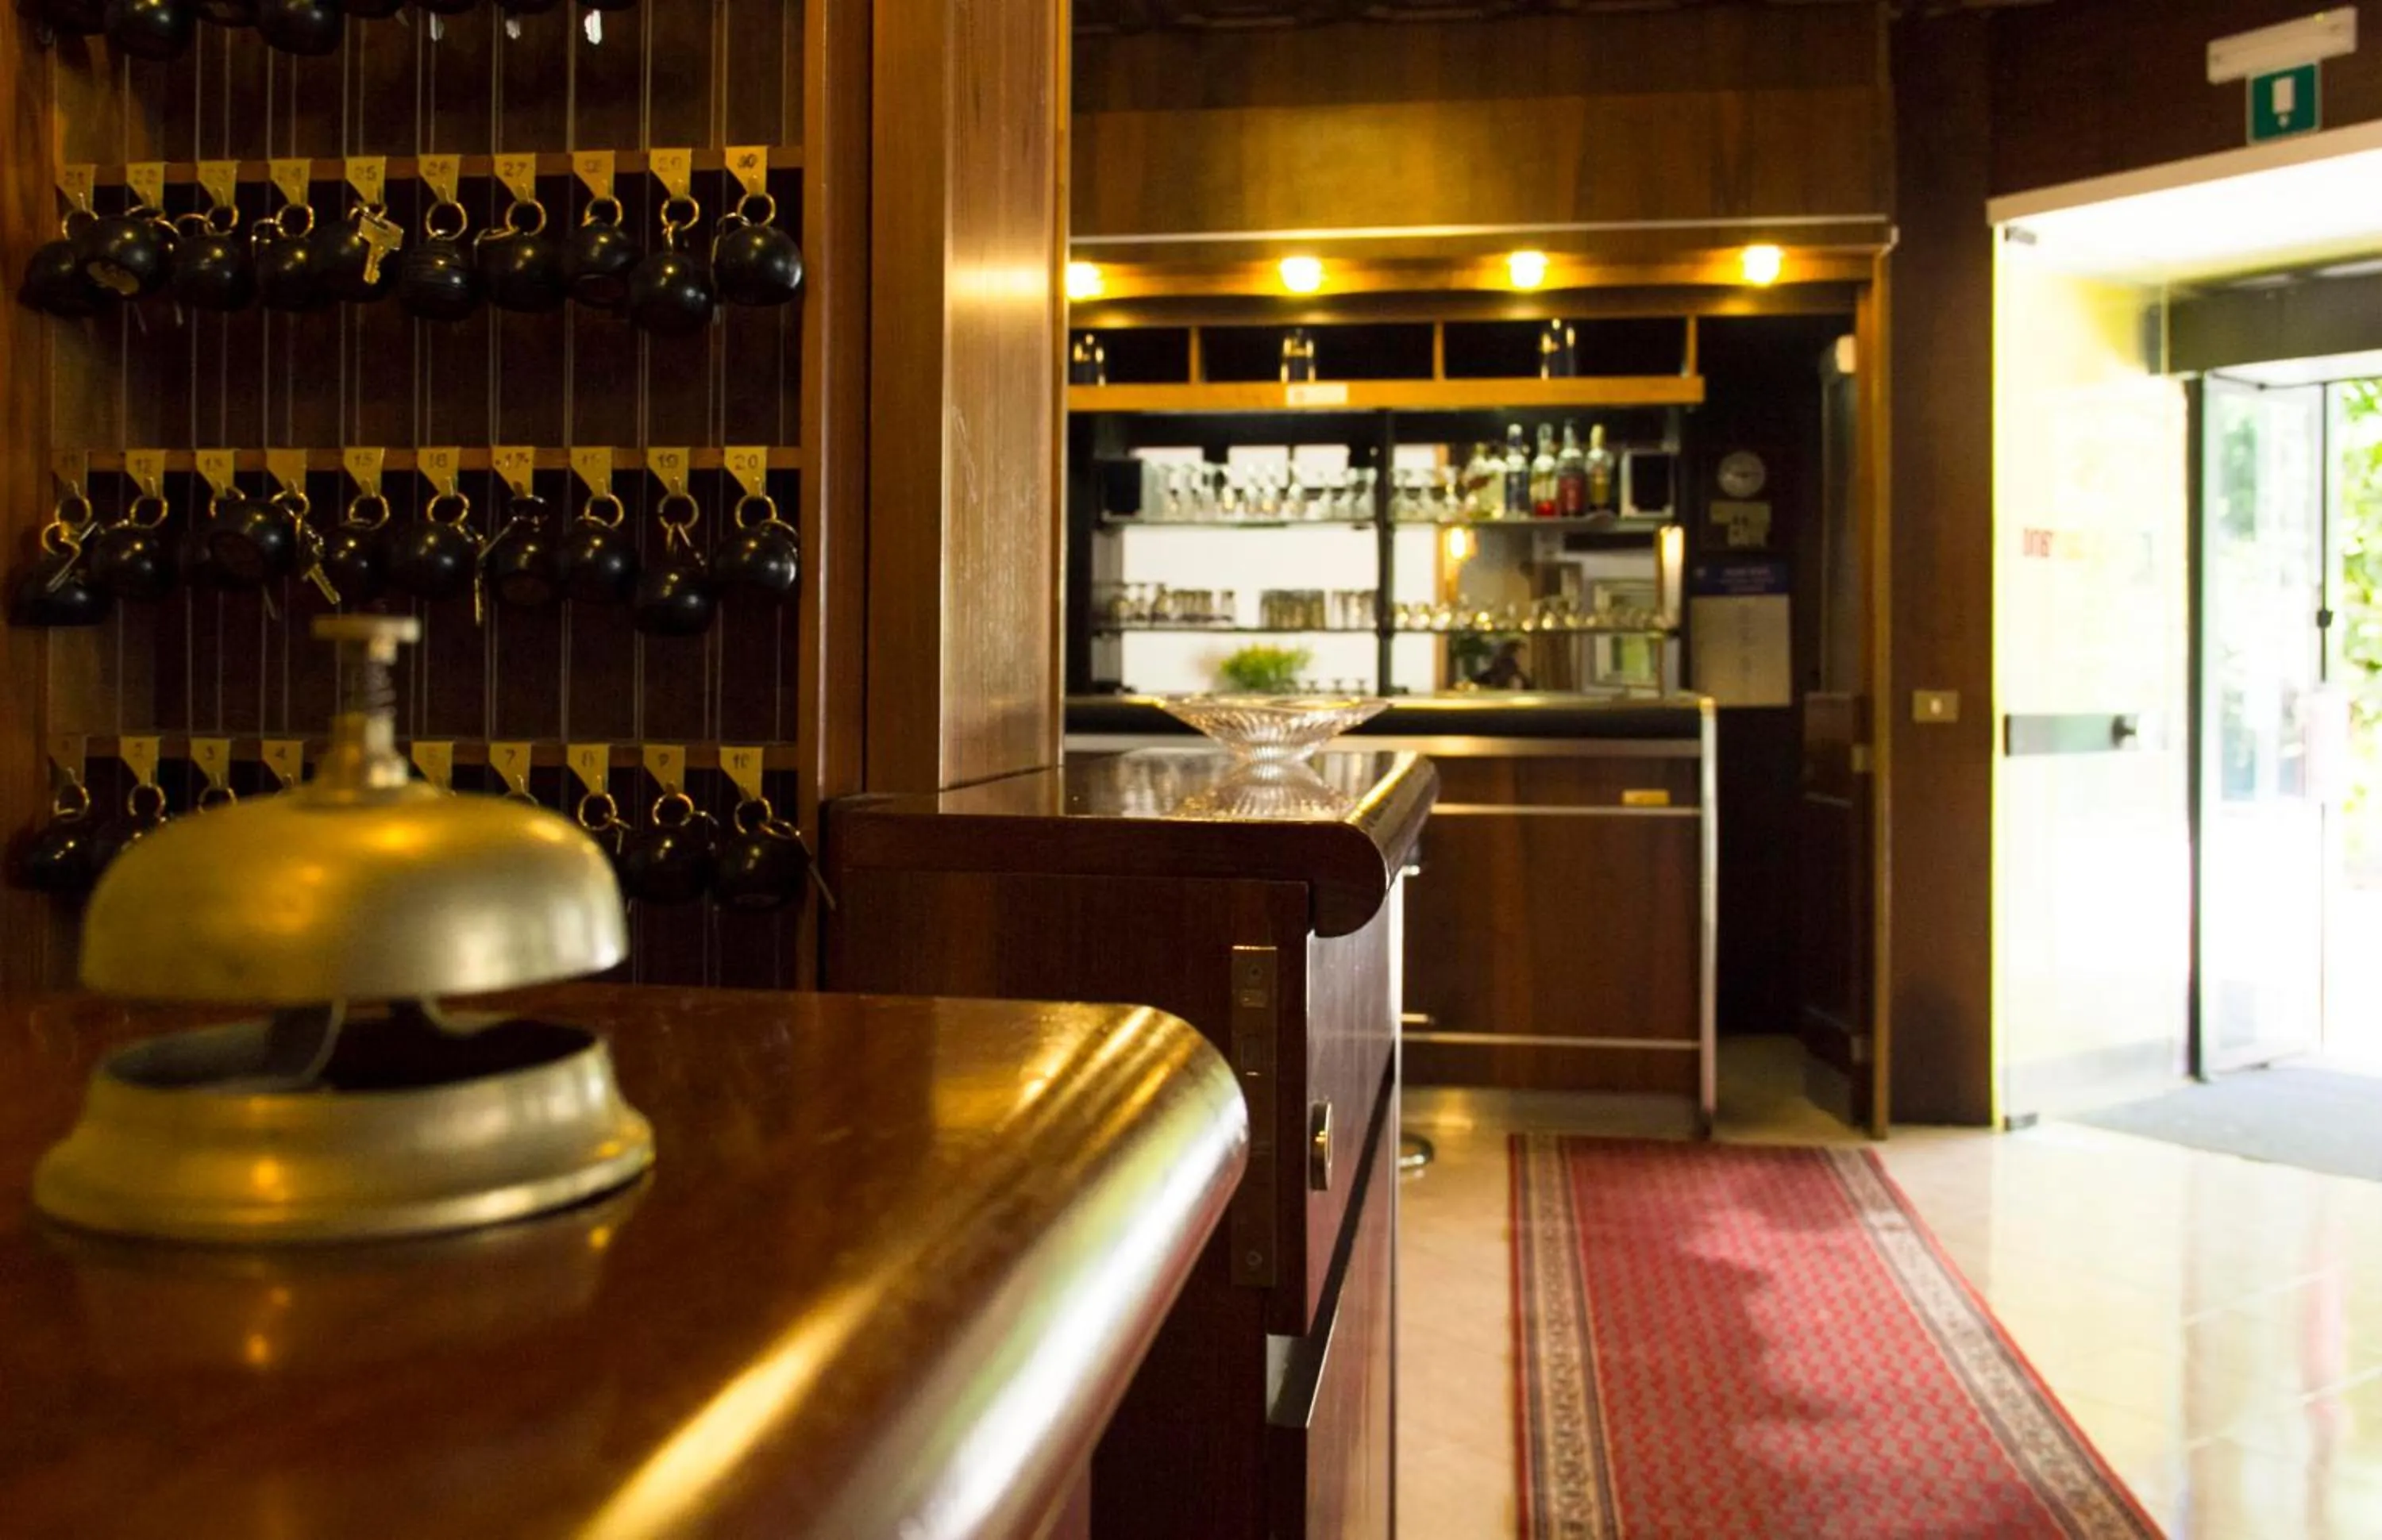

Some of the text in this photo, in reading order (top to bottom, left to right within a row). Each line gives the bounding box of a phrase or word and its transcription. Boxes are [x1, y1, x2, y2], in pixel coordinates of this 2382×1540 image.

[355, 165, 377, 181] 25
[503, 162, 526, 178] 27
[64, 171, 84, 187] 21
[658, 452, 679, 468] 19
[734, 453, 758, 470] 20
[505, 749, 516, 766] 7
[658, 753, 669, 768] 9
